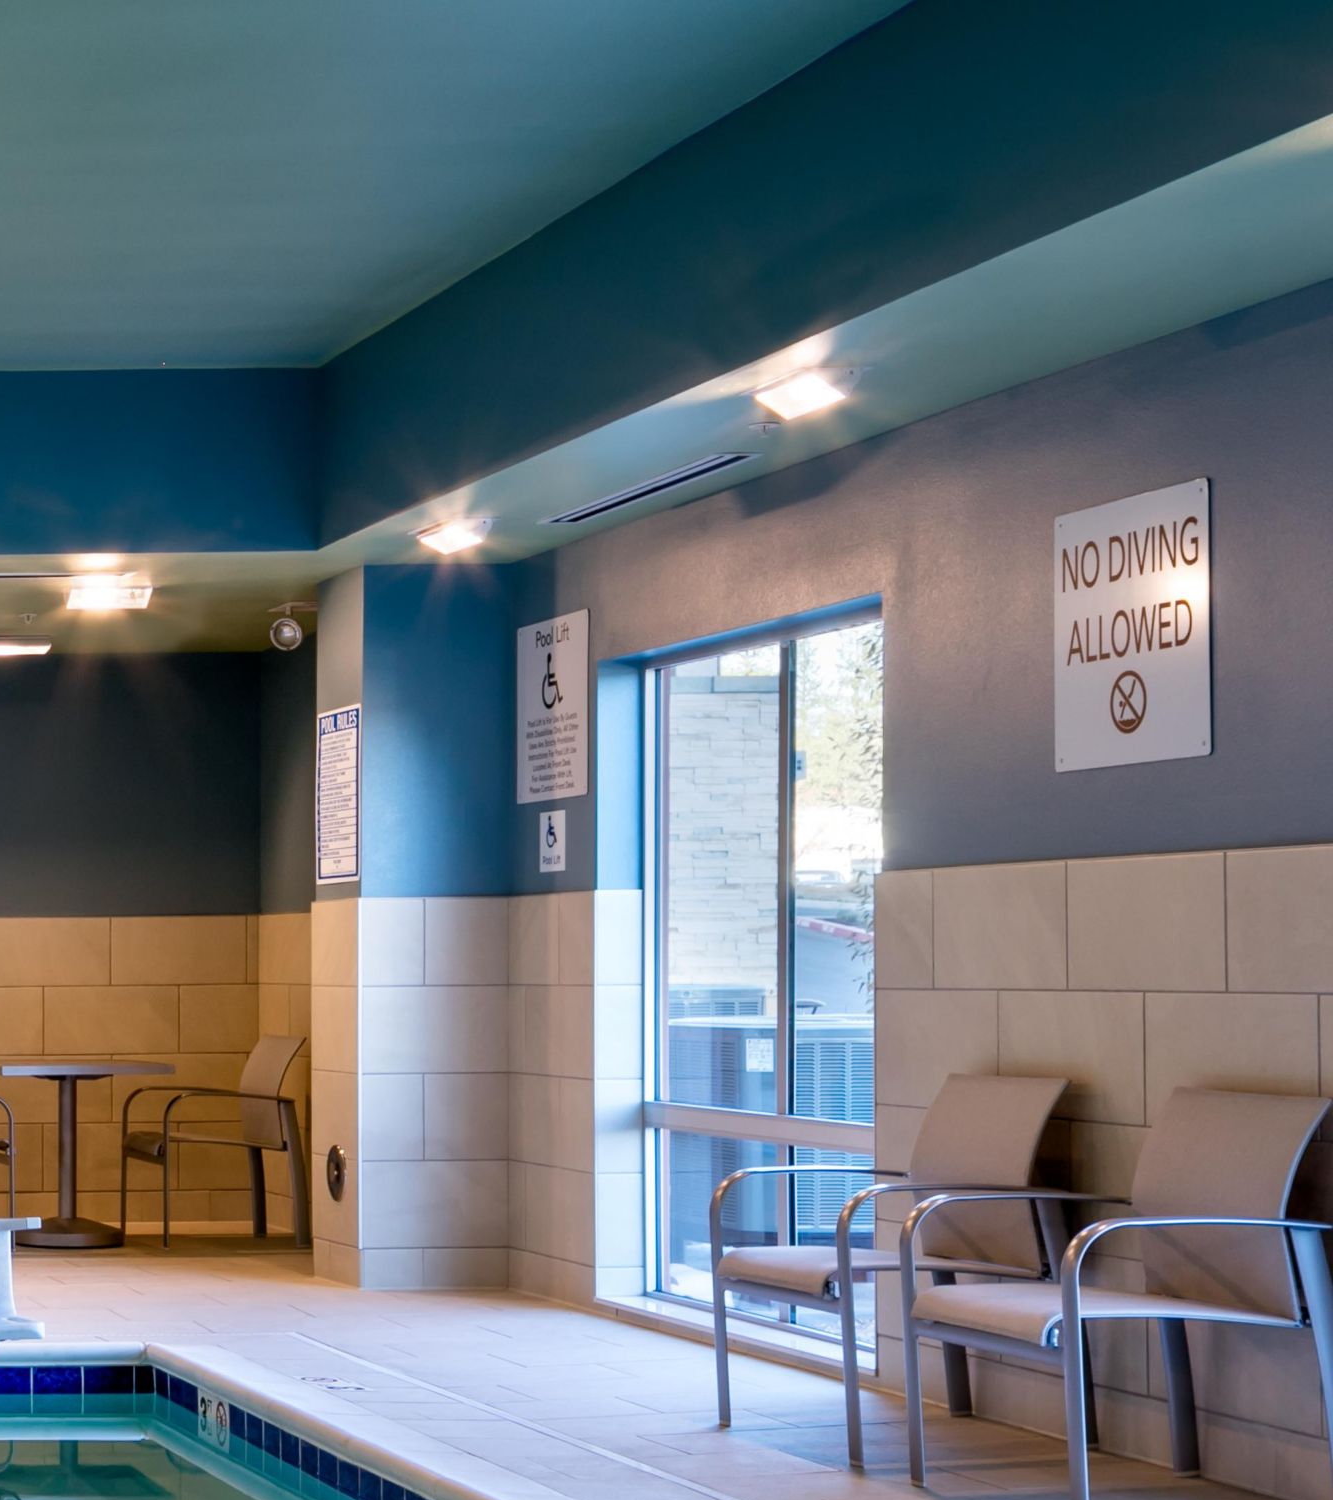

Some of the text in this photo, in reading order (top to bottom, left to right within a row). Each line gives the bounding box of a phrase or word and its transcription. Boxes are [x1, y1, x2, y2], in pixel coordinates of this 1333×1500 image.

[1062, 516, 1199, 593] NO DIVING
[535, 621, 570, 648] Pool Lift
[1067, 598, 1193, 666] ALLOWED
[321, 710, 357, 734] POOL RULES
